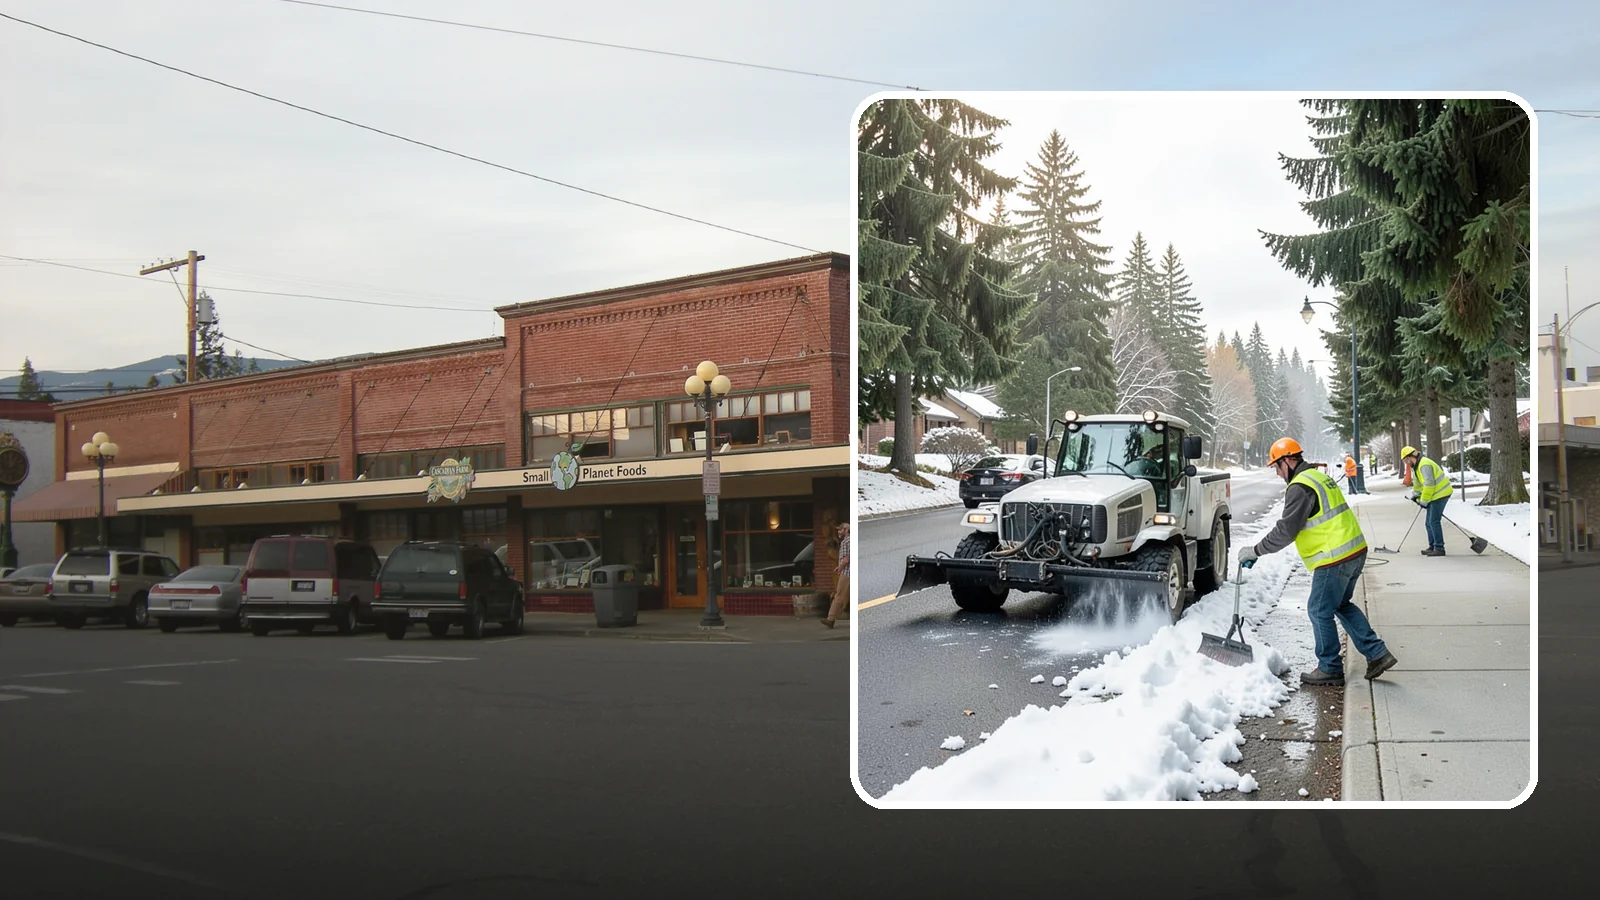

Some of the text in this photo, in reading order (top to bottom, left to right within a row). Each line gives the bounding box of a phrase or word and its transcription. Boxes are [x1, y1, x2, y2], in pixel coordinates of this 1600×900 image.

[456, 466, 469, 474] FARM
[523, 464, 647, 483] Small Planet Foods
